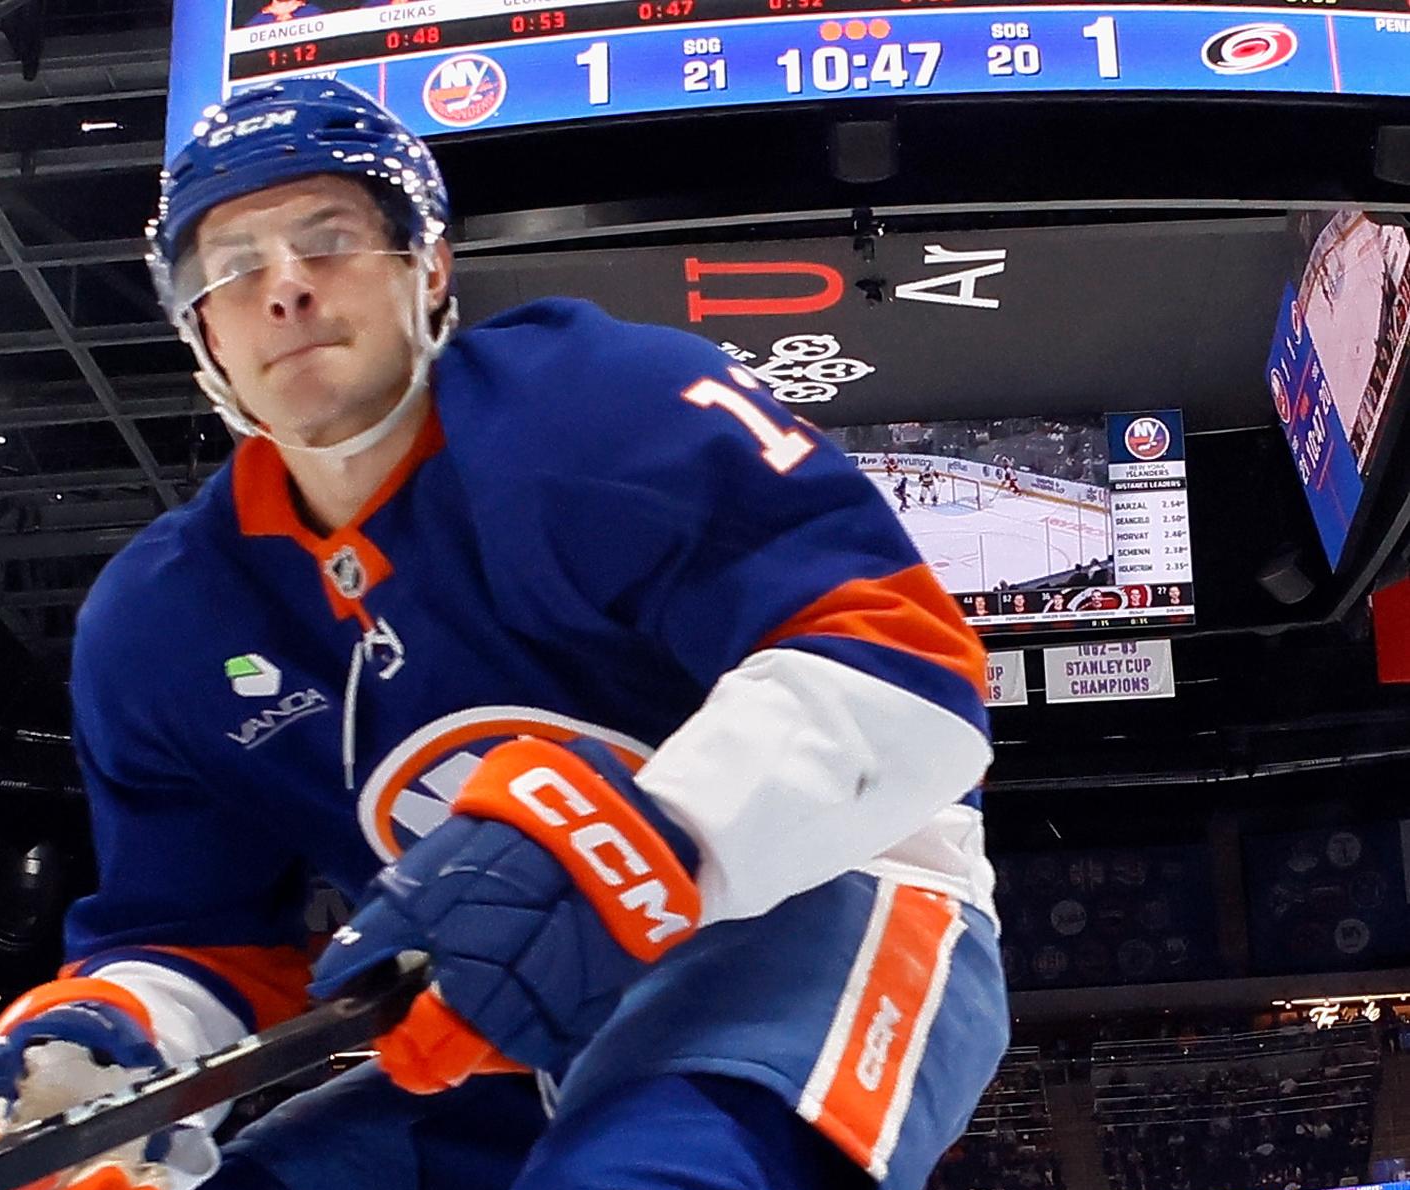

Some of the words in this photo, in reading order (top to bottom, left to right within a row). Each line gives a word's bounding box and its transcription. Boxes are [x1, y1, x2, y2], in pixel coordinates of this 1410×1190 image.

[378, 5, 437, 23] CIZIKAS
[510, 11, 567, 33] 0:53
[249, 21, 325, 44] DEANGELO
[386, 26, 441, 49] 0:48
[990, 21, 1031, 39] SOG
[1374, 18, 1410, 34] PEN
[267, 44, 318, 67] 1:12
[683, 37, 722, 56] SOG
[1082, 16, 1121, 80] 1
[776, 41, 943, 95] 10:47
[986, 43, 1042, 77] 20
[575, 41, 613, 105] 1
[683, 58, 729, 93] 21
[208, 109, 298, 147] CCM
[681, 365, 827, 475] 1
[986, 666, 1004, 682] UP
[1065, 660, 1123, 677] STANLEY
[1125, 658, 1152, 673] CUP
[1070, 678, 1150, 695] CHAMPIONS
[226, 687, 328, 746] VANDA
[508, 766, 692, 944] CCM
